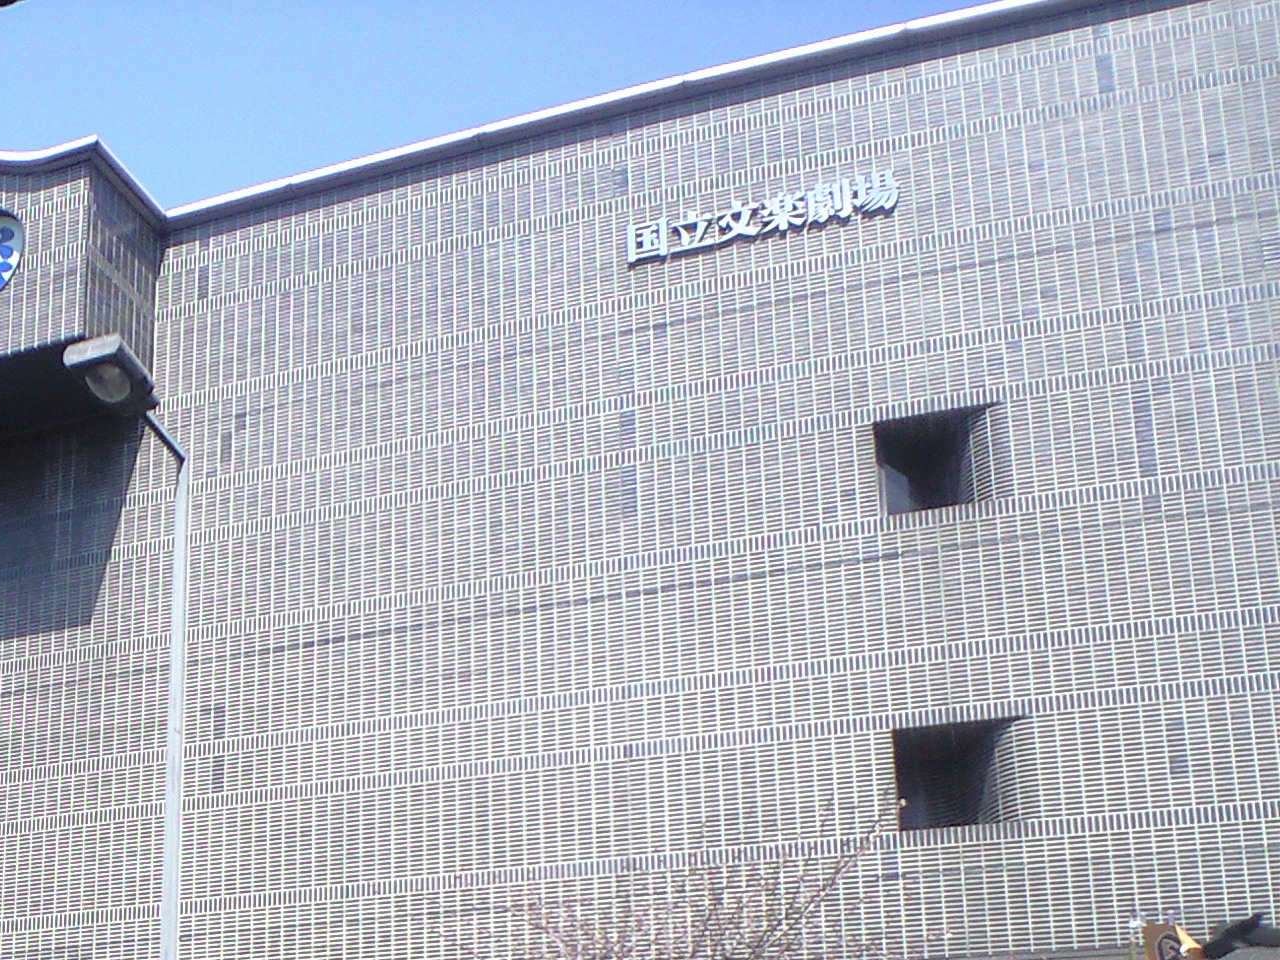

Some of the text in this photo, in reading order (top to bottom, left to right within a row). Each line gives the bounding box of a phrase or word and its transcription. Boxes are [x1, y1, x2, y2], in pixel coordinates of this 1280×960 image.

[627, 169, 900, 264] 国立文楽劇場
